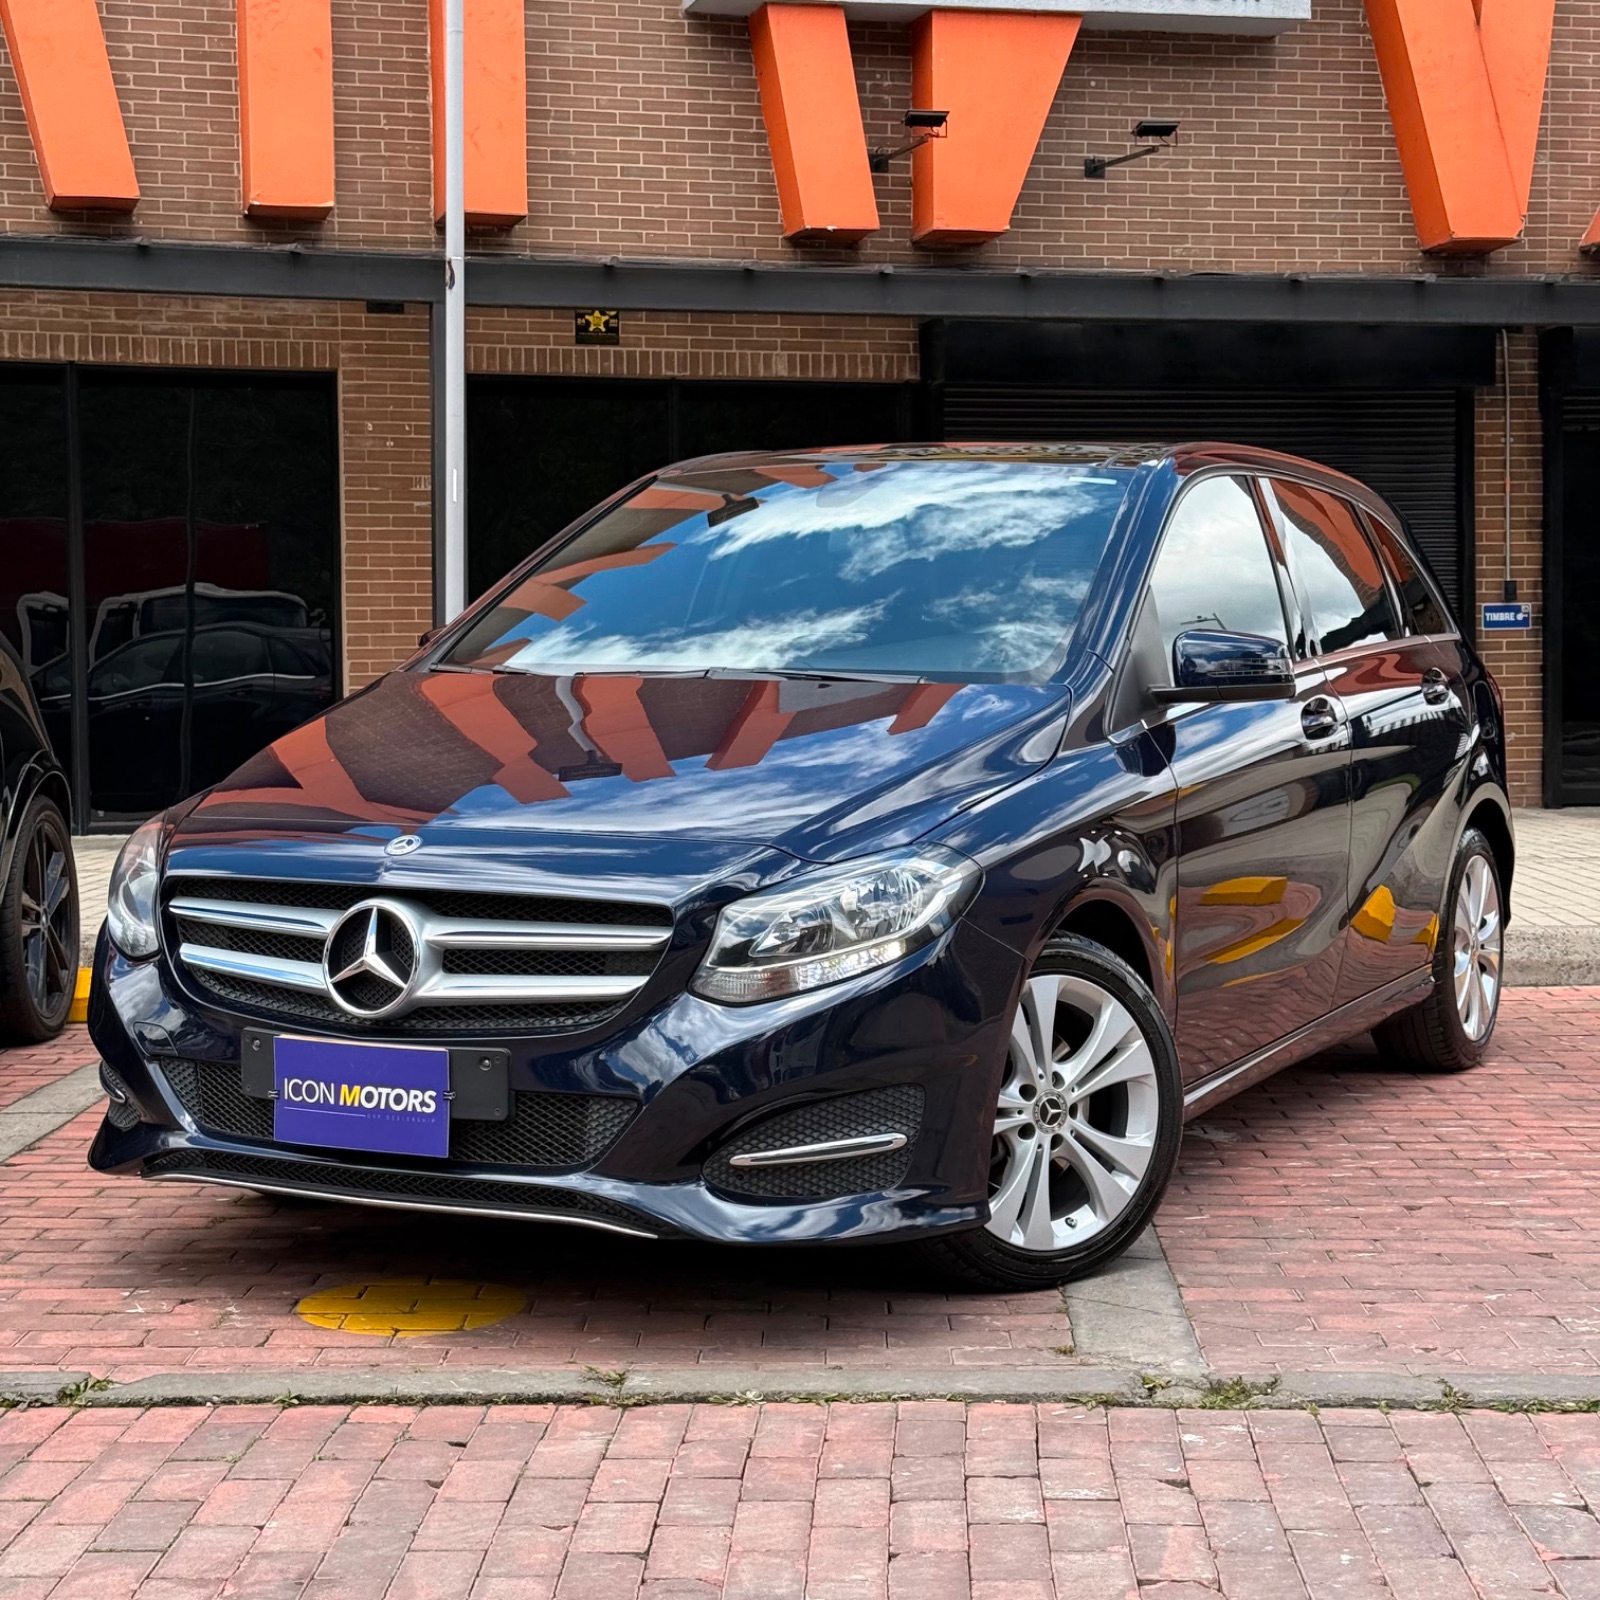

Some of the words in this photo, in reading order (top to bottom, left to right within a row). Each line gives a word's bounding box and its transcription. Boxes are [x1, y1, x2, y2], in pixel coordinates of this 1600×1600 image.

[1485, 612, 1516, 621] TIMBRE
[283, 1078, 335, 1104] ICON
[339, 1084, 437, 1113] MOTORS
